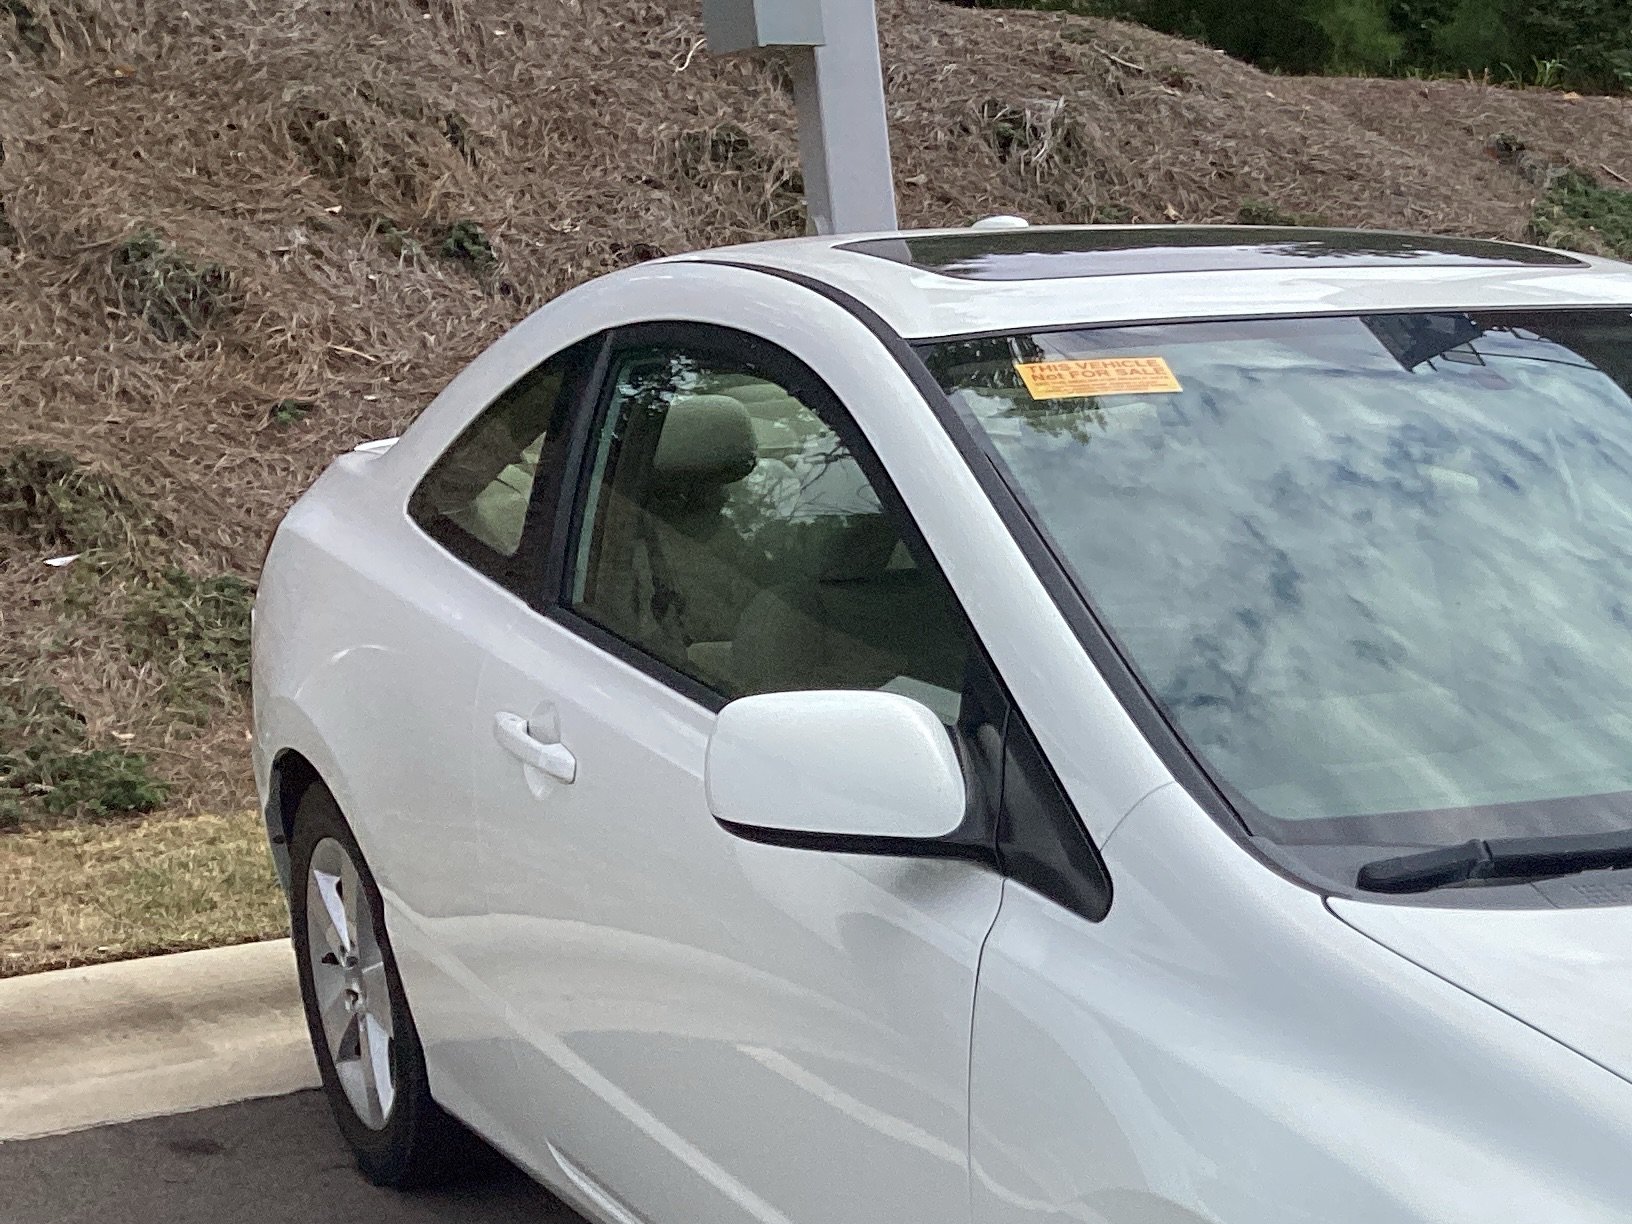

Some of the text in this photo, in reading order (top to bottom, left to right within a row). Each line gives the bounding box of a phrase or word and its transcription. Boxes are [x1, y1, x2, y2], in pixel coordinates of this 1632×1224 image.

[1027, 359, 1161, 374] THIS VEHICLE
[1070, 368, 1109, 379] FOR
[1116, 366, 1167, 377] SALE
